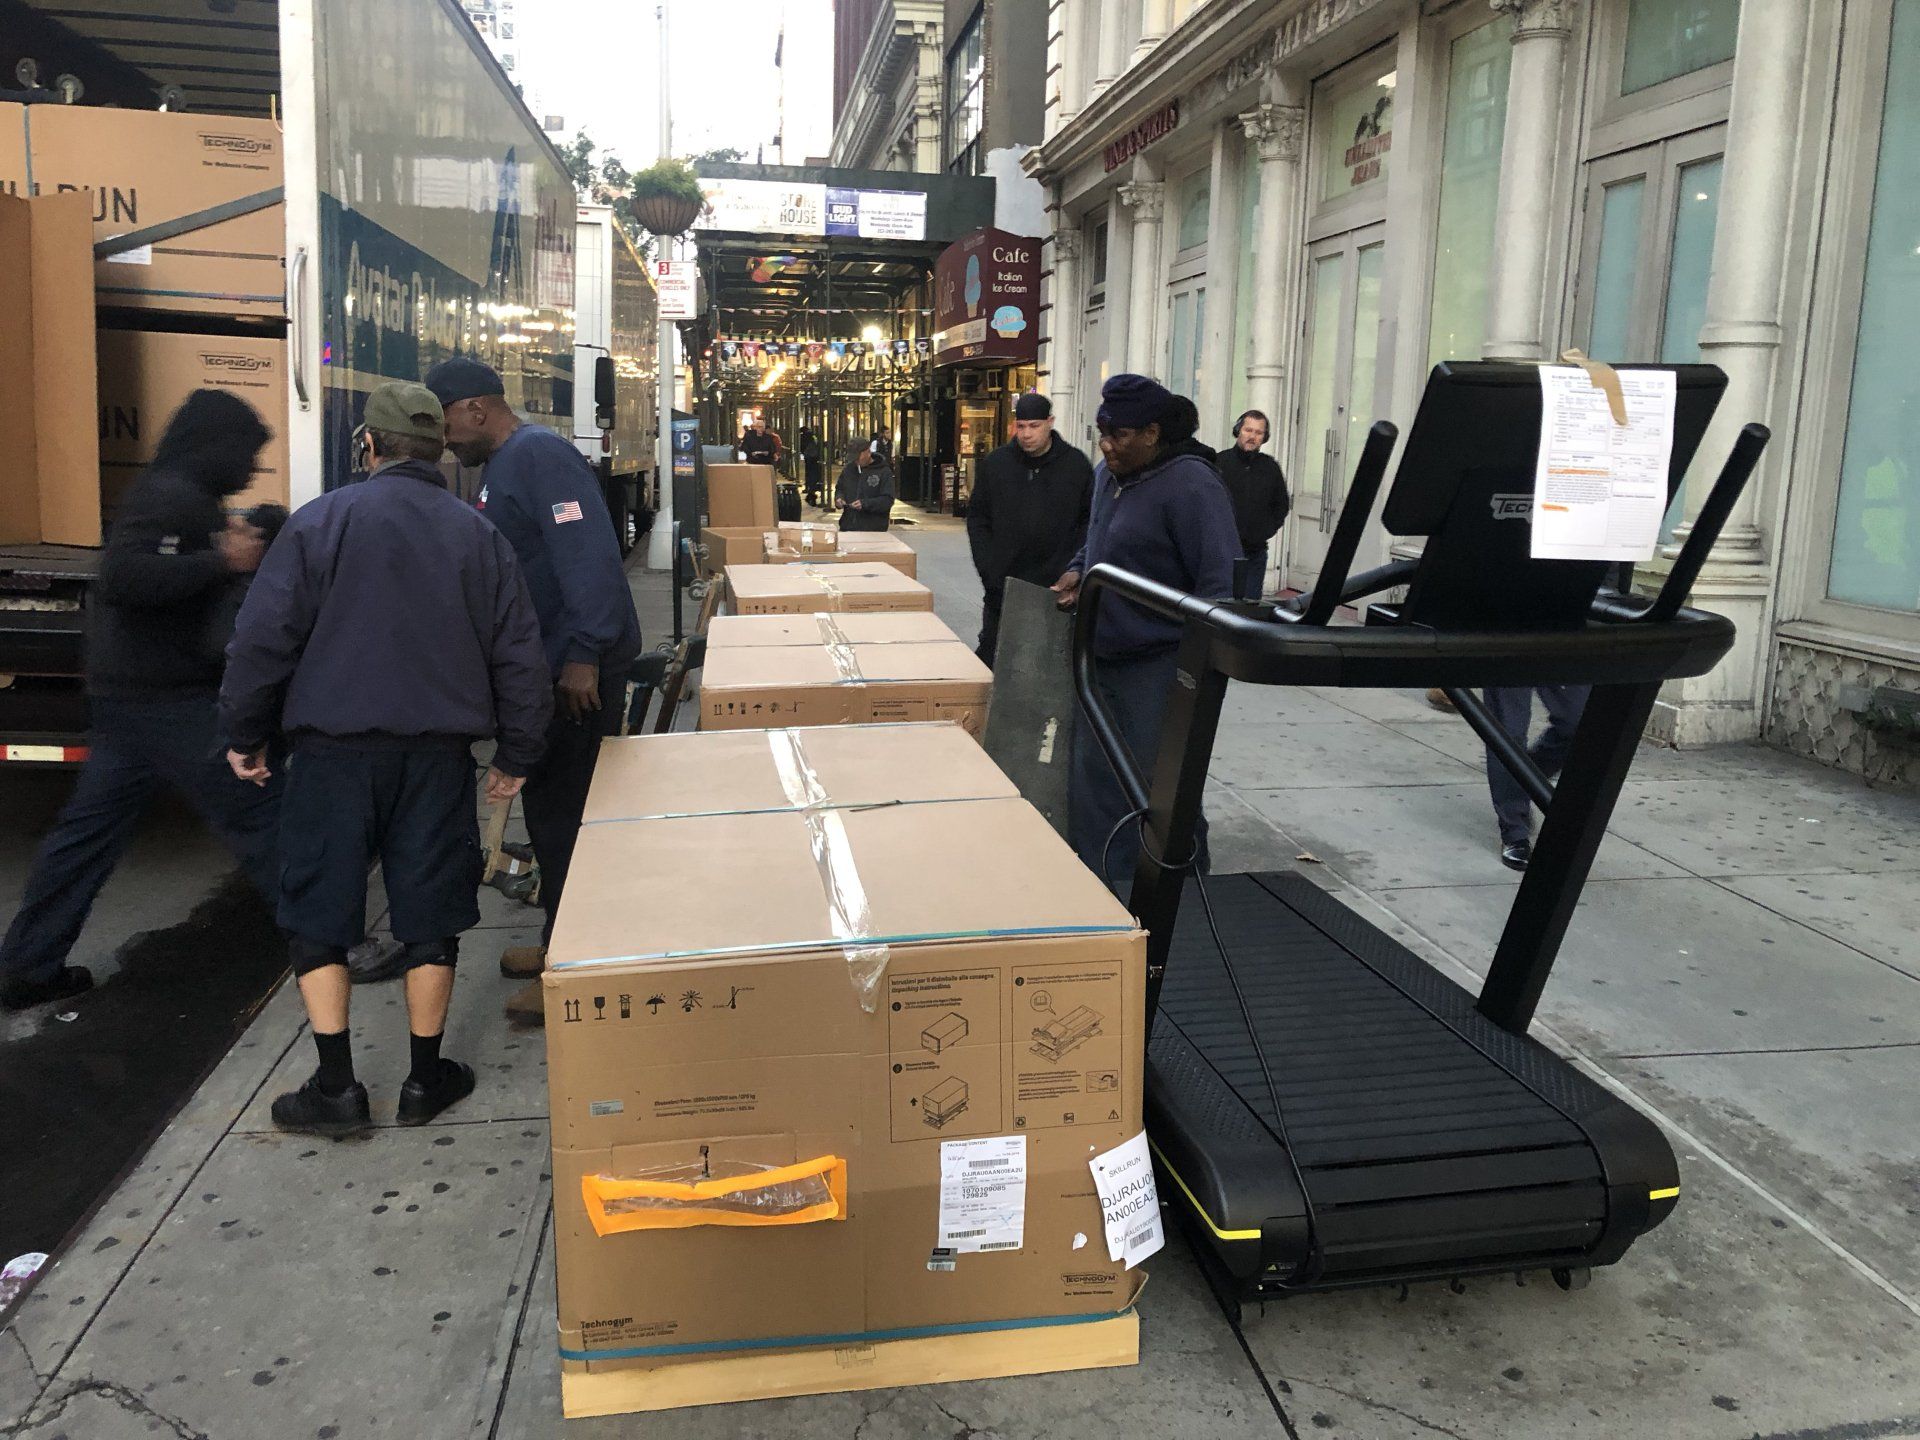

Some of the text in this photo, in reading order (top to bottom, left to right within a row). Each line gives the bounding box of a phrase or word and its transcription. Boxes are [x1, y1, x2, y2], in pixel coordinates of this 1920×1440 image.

[832, 205, 853, 214] BUD
[780, 208, 817, 224] HOUSE
[829, 213, 857, 223] LIGHT
[992, 247, 1030, 263] Cafe
[660, 263, 669, 275] 3
[997, 271, 1023, 282] Italian
[345, 240, 409, 335] Avatar
[992, 283, 1028, 293] Ice Cream
[680, 432, 691, 449] P
[1109, 1156, 1141, 1178] SKILLRUN
[581, 1317, 633, 1329] Technogym
